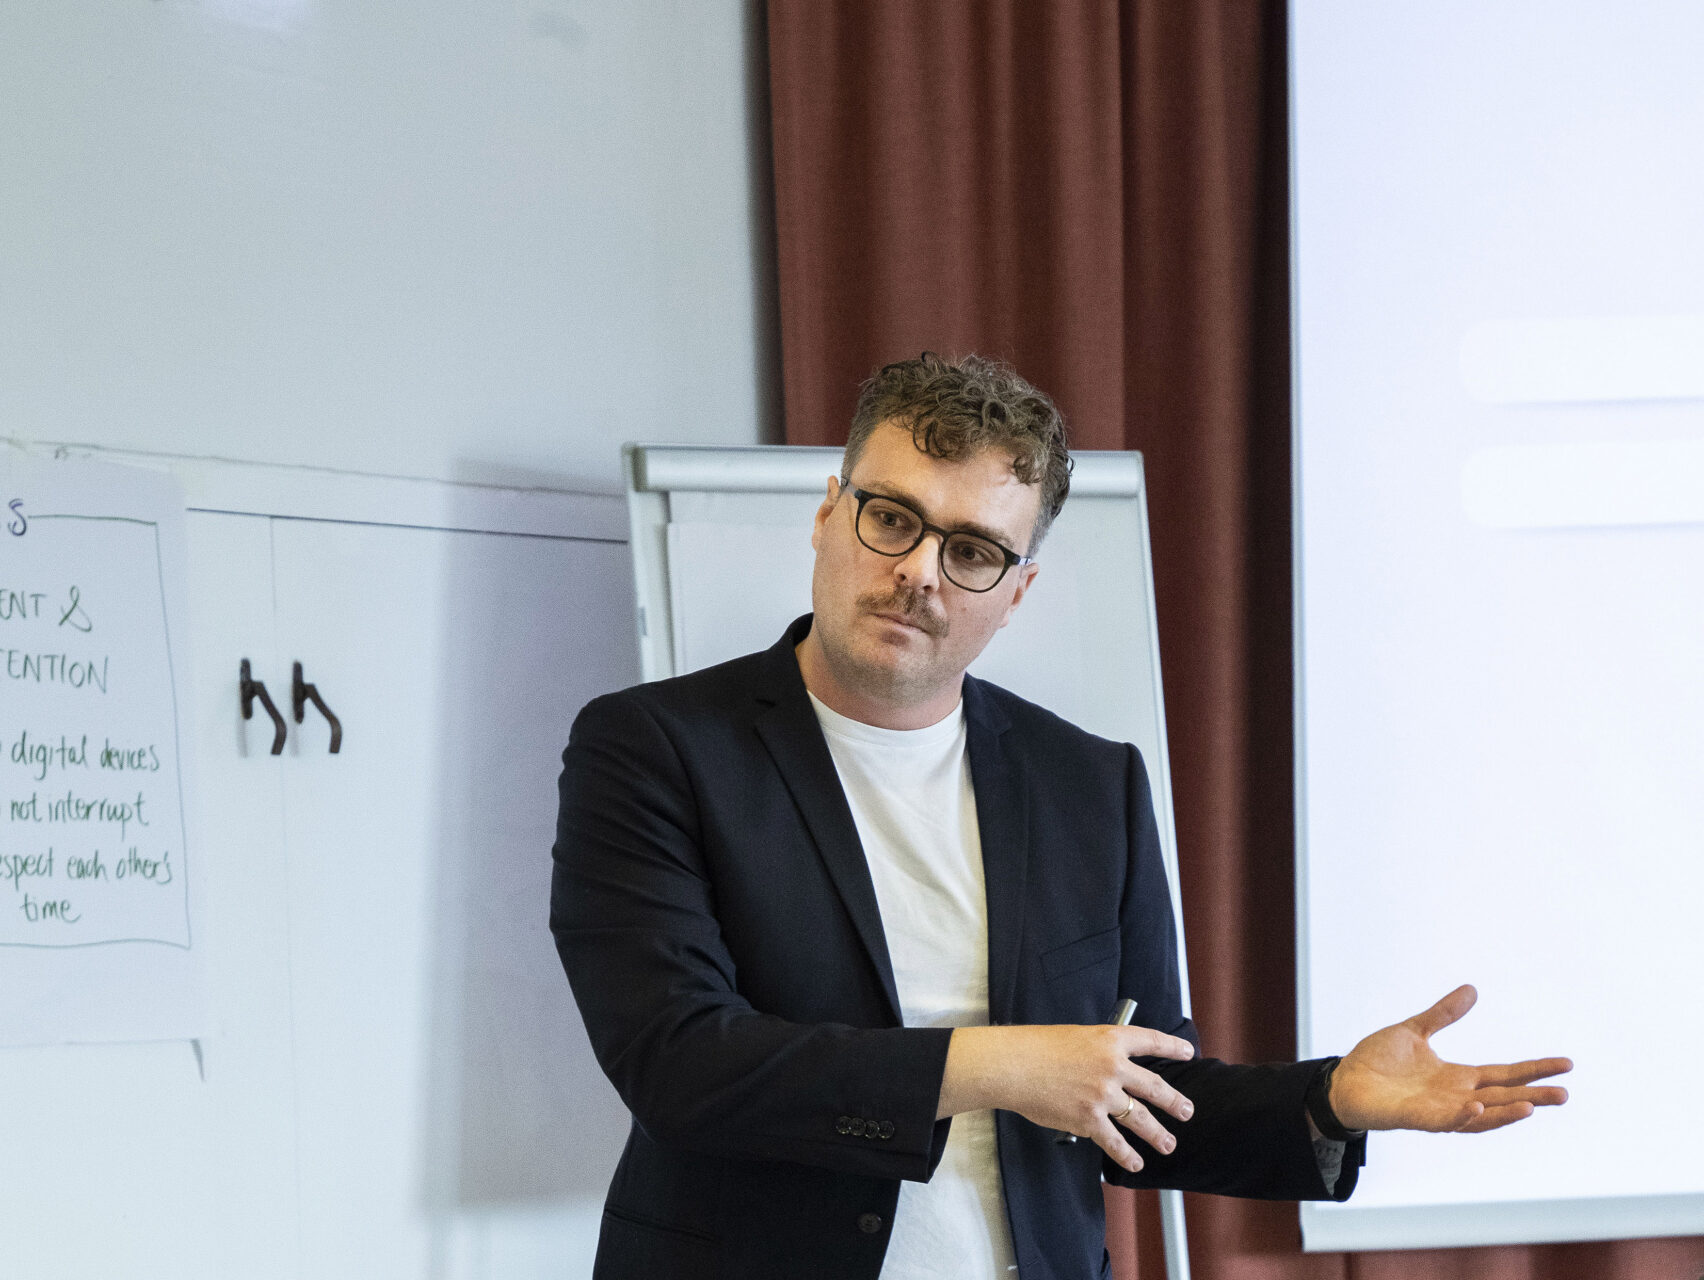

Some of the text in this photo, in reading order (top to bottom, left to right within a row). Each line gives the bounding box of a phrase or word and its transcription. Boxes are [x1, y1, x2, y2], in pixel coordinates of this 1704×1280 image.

[0, 648, 109, 694] ENTION
[11, 729, 160, 781] digital devices
[10, 789, 149, 841] not interrupt
[0, 845, 54, 891] spect
[66, 849, 109, 882] each
[19, 892, 82, 923] time
